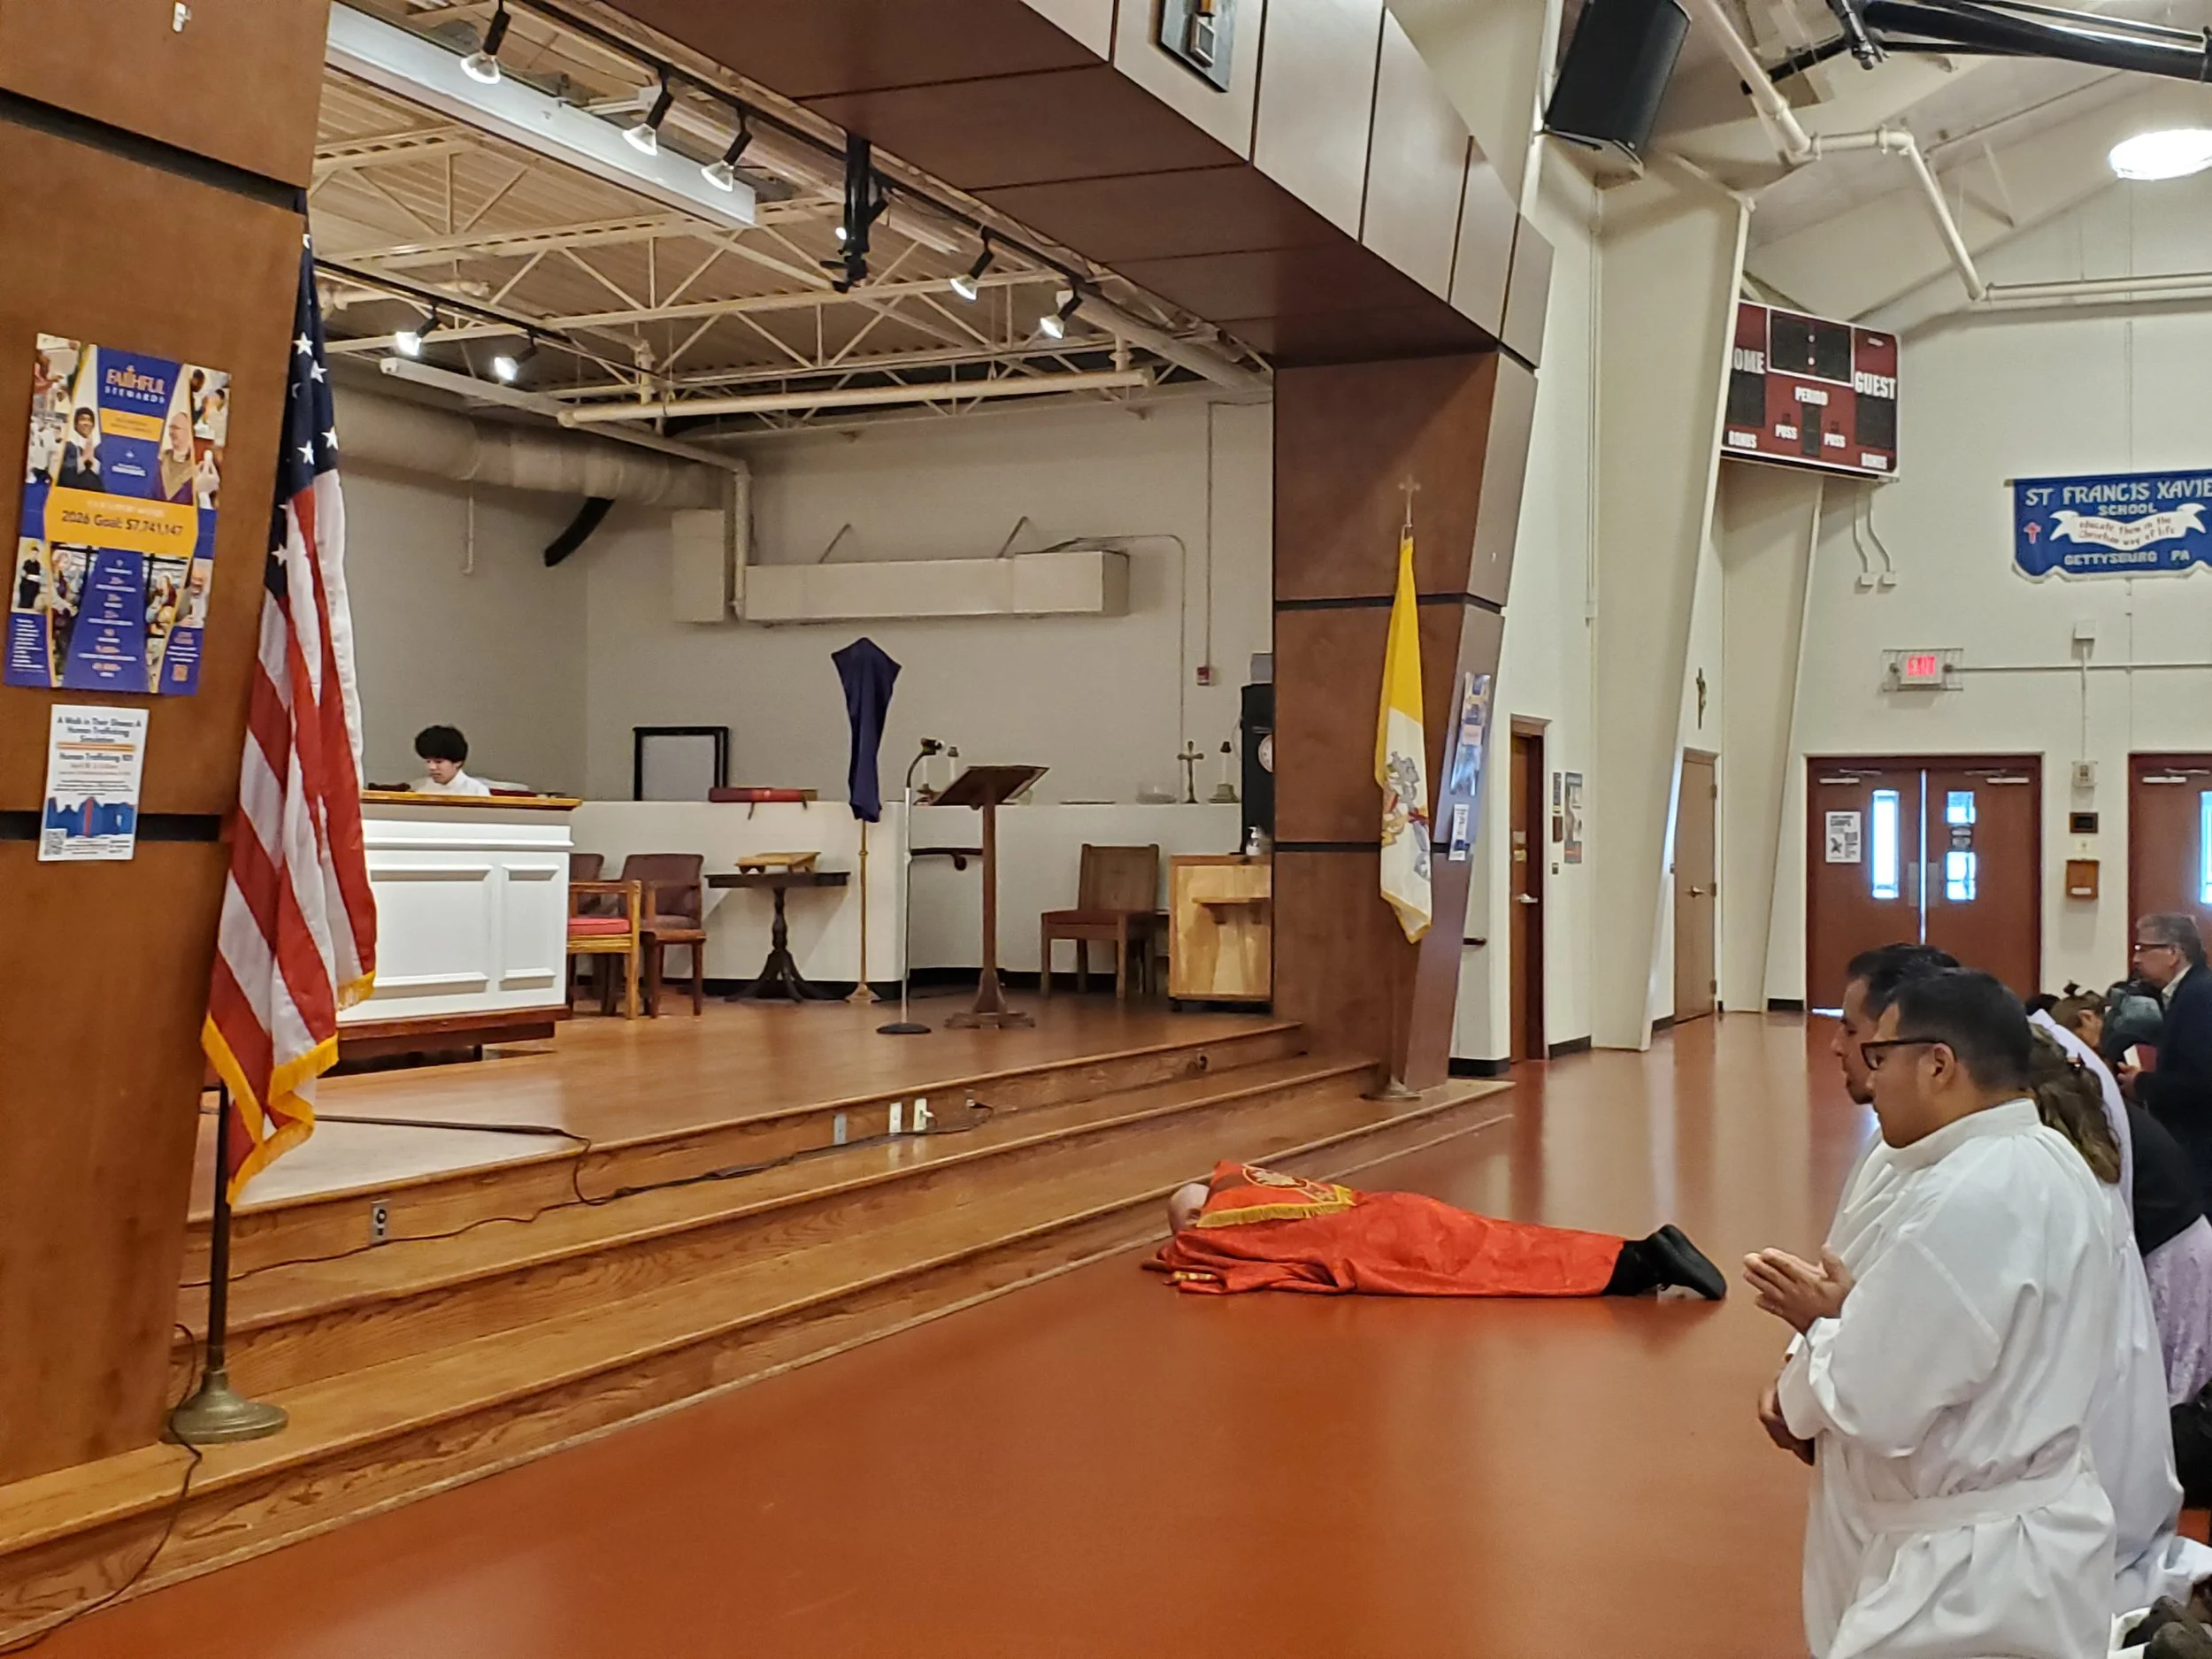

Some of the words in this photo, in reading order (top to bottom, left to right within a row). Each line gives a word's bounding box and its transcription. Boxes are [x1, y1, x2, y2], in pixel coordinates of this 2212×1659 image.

[1734, 348, 1766, 374] OME
[104, 385, 166, 404] STEWARDS
[1794, 386, 1829, 406] PERIOD
[1855, 371, 1896, 400] GUEST
[2024, 488, 2054, 506] ST
[2062, 483, 2152, 506] FRANCIS
[2156, 479, 2212, 499] XAVIE
[2098, 502, 2158, 517] SCHOOL
[2063, 550, 2158, 566] GETTYSBURG
[2170, 549, 2190, 562] PA
[1907, 655, 1936, 677] EXIT
